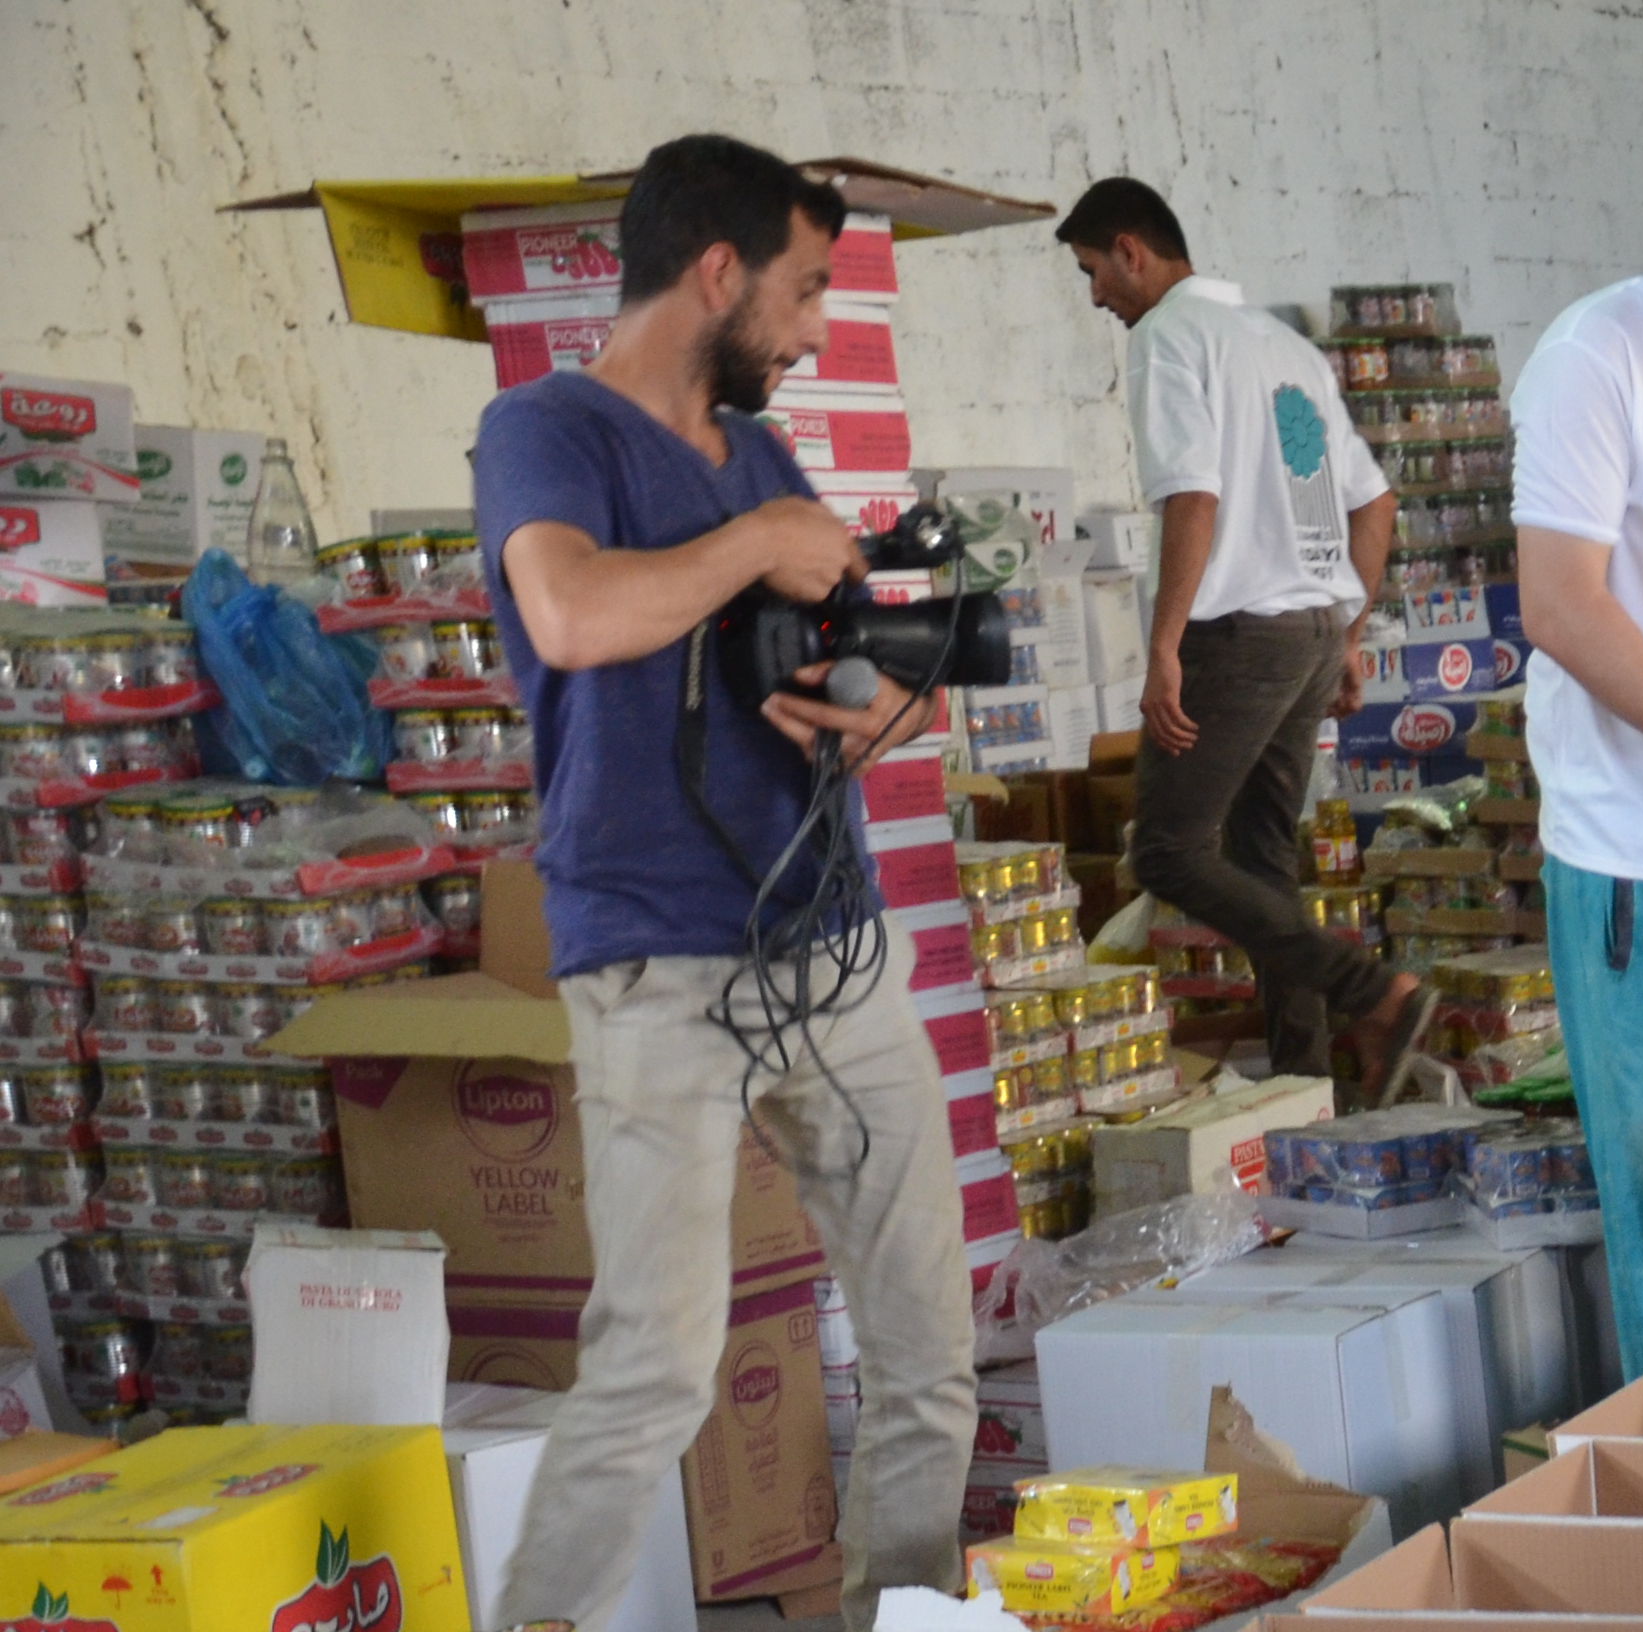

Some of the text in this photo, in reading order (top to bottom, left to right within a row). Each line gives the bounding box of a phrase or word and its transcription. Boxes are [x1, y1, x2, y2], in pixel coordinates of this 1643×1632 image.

[464, 1083, 545, 1114] Lipton
[470, 1166, 559, 1190] YELLOW
[483, 1193, 554, 1216] LABEL
